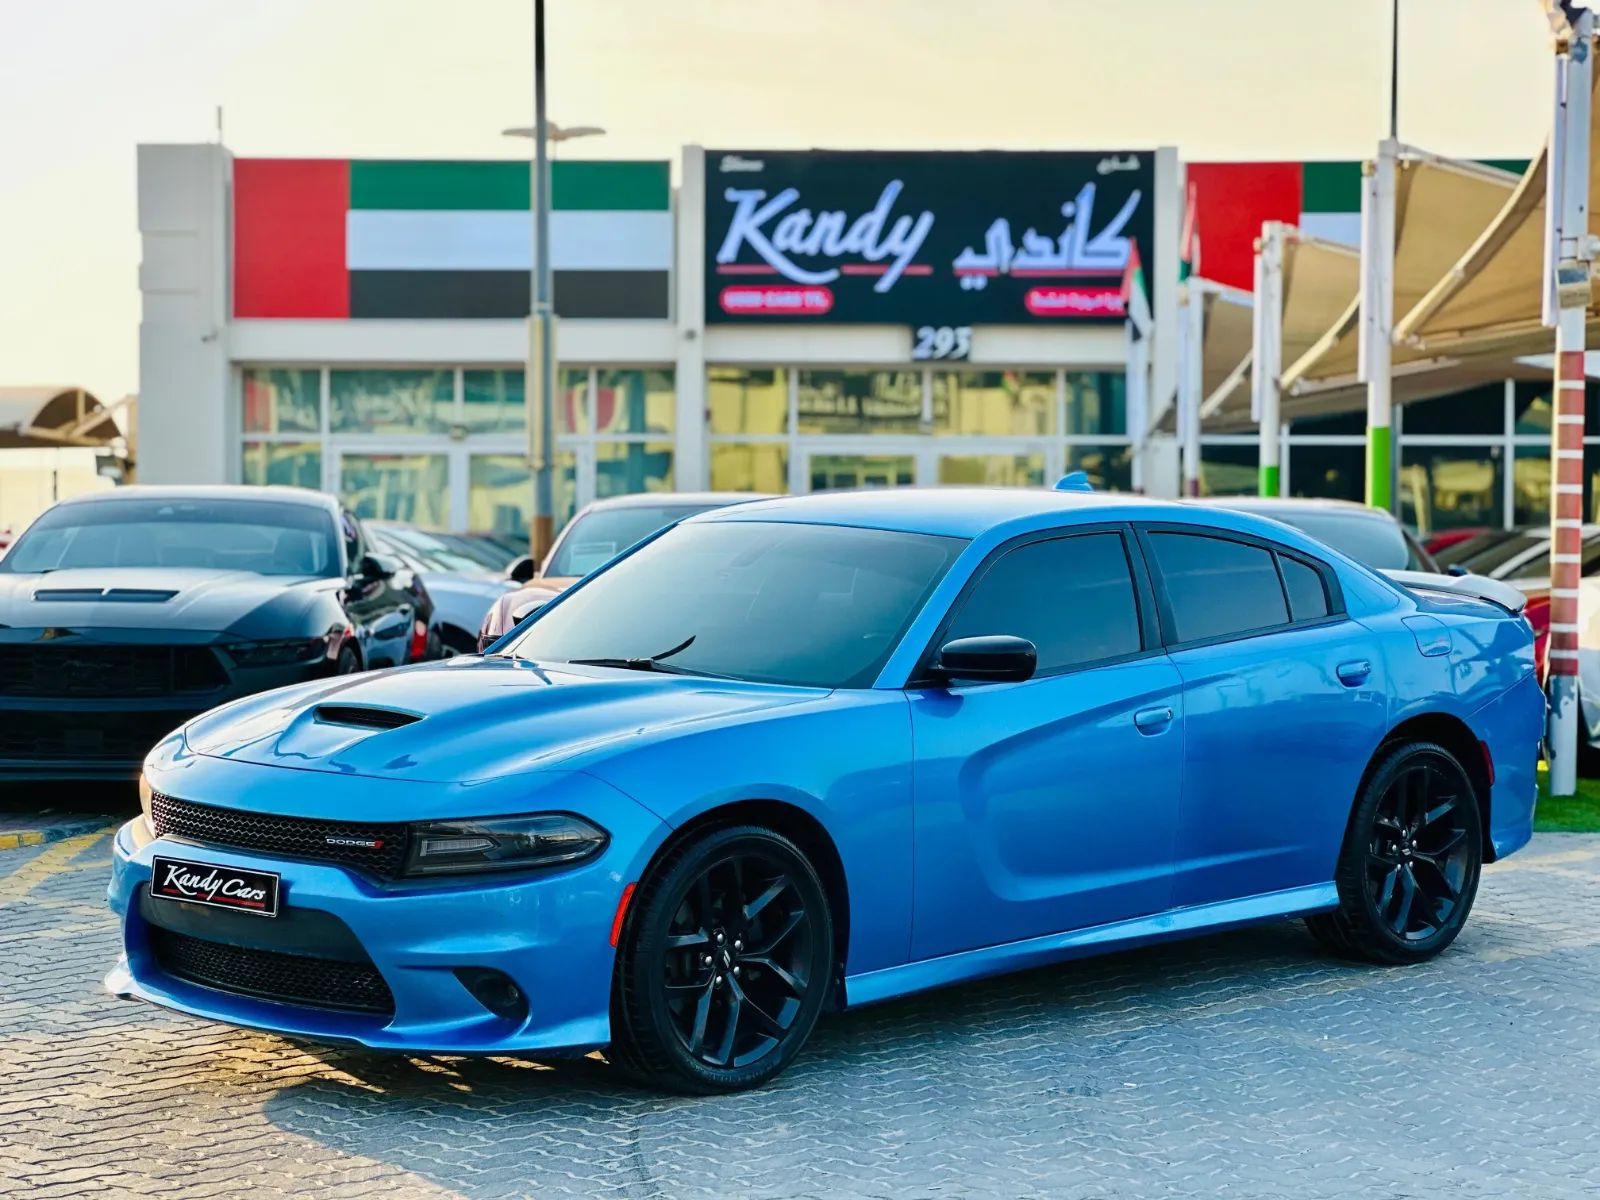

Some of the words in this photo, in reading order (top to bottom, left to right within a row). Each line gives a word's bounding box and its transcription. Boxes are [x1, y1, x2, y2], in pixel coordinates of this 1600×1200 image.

[716, 179, 935, 293] Kandy
[952, 181, 1142, 290] كاندي
[912, 326, 972, 360] 295
[326, 838, 377, 847] DODGE
[163, 864, 222, 901] Kandy
[221, 878, 266, 900] Cars
